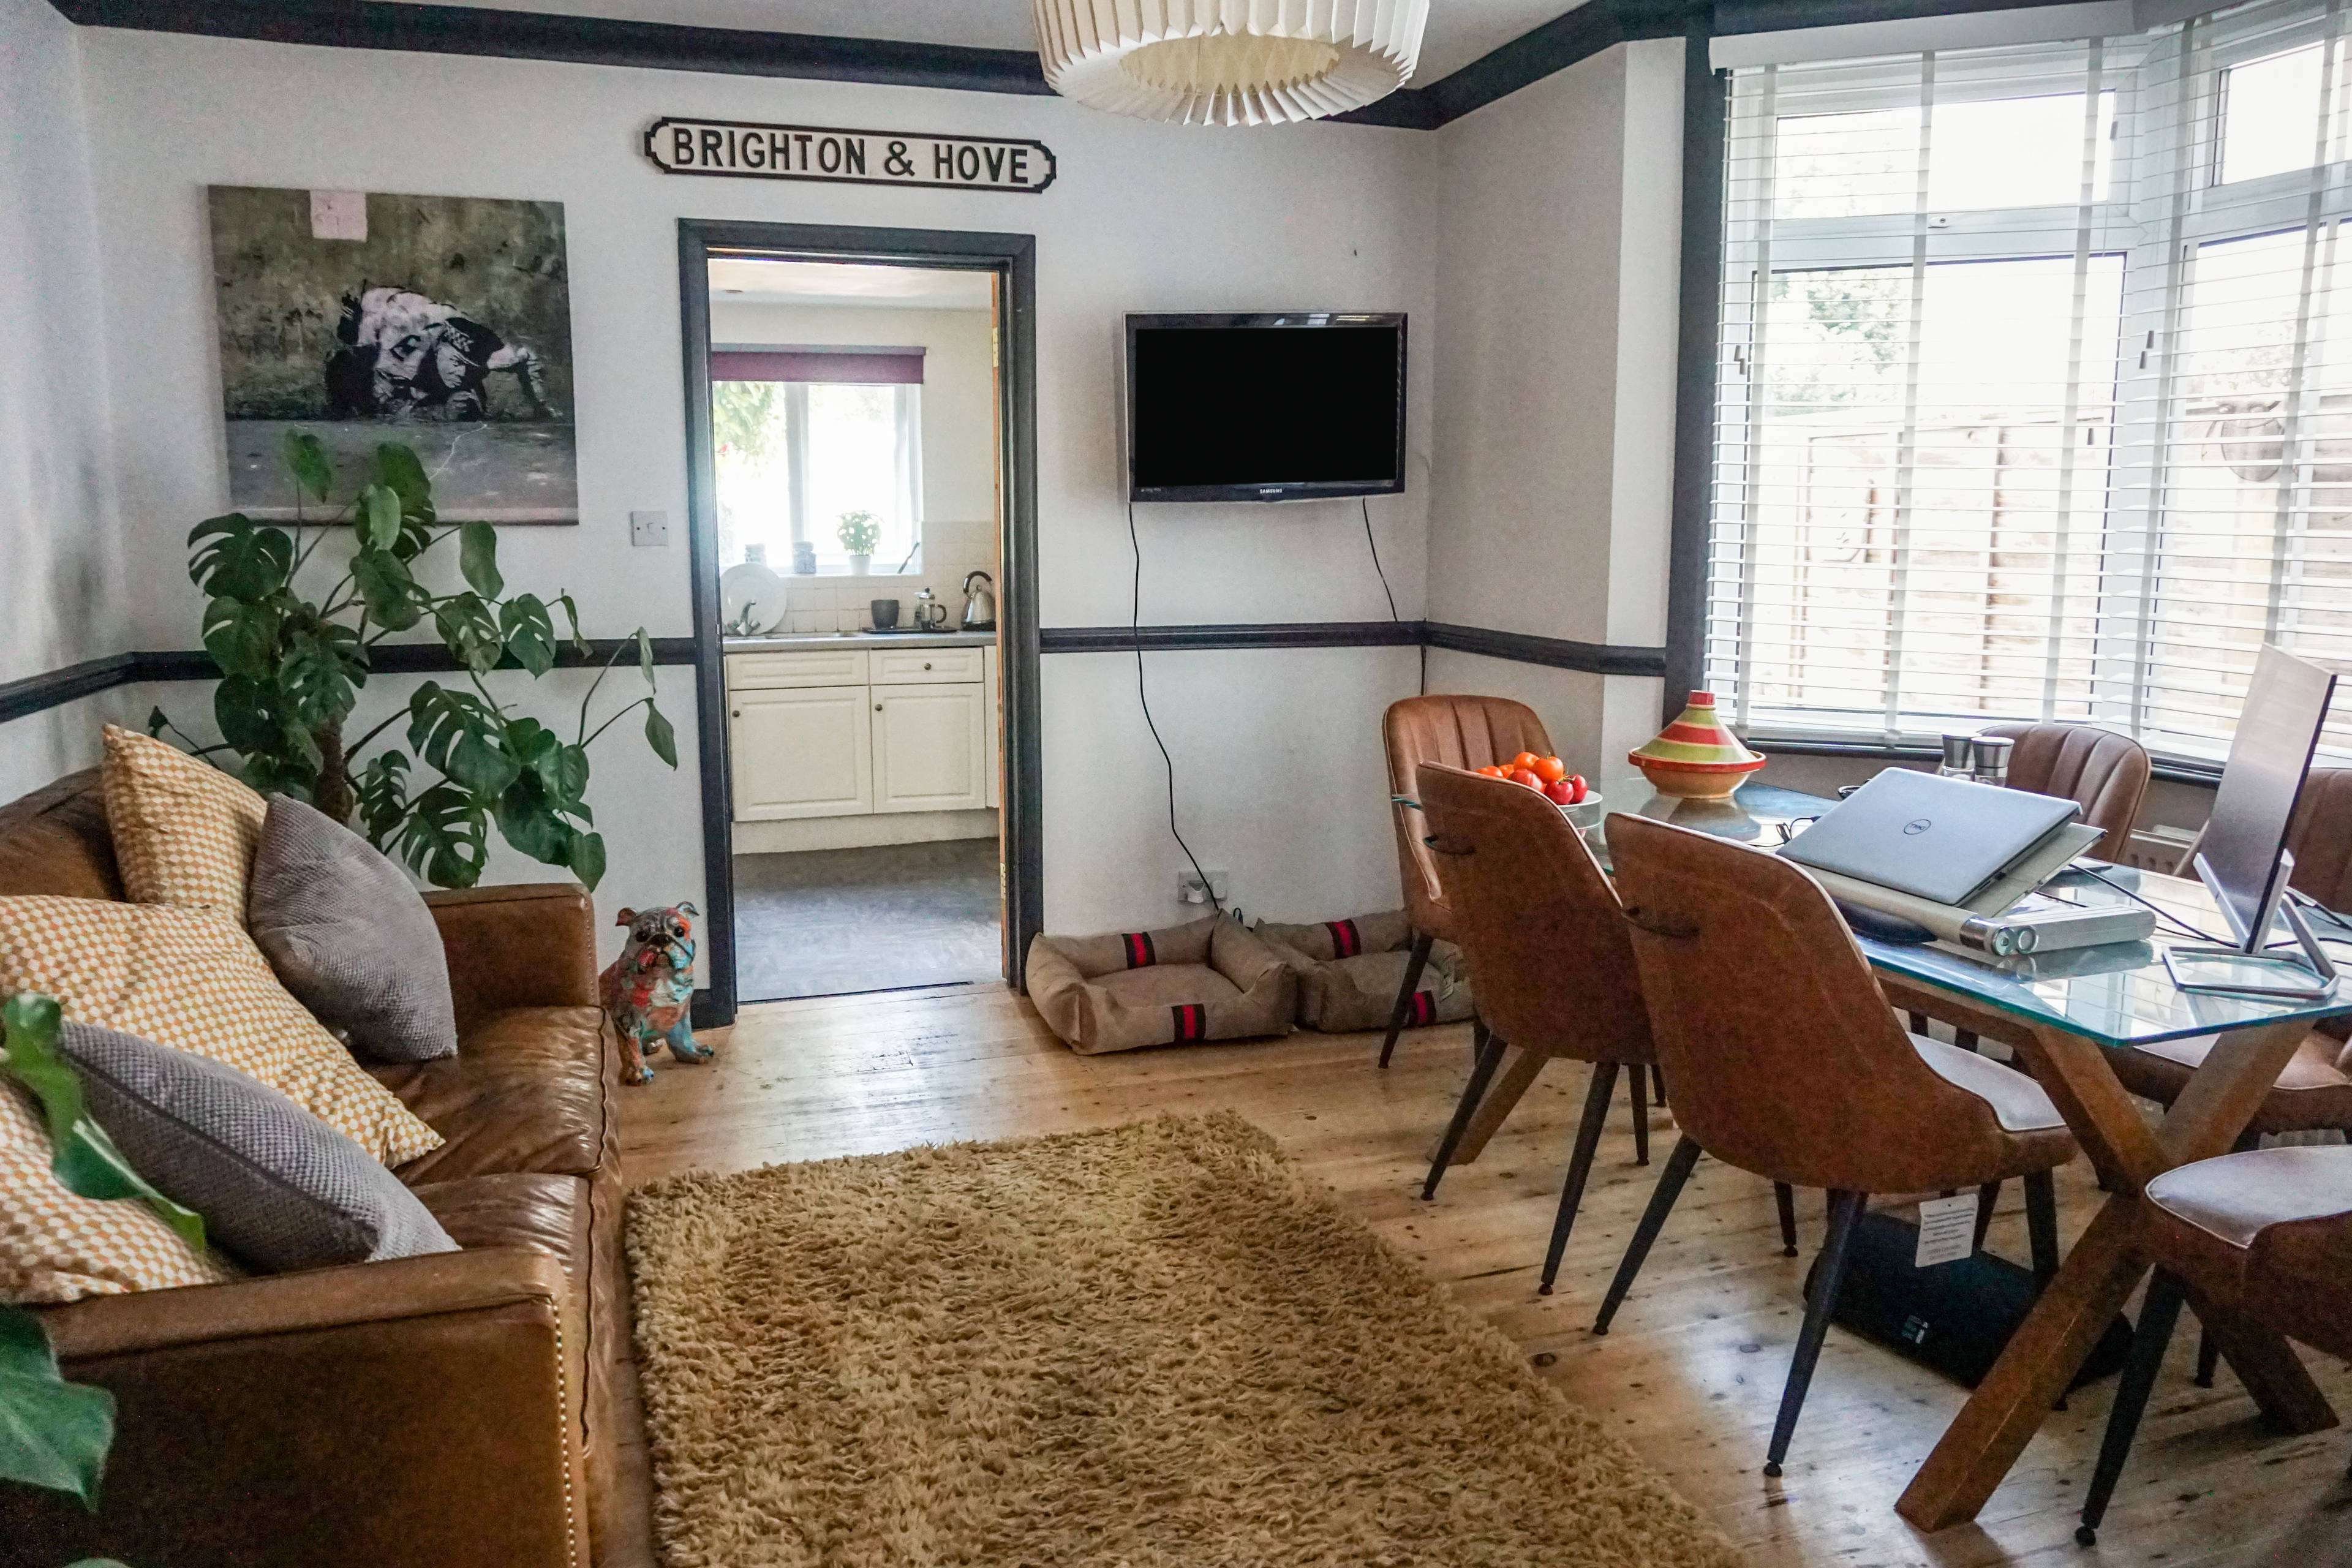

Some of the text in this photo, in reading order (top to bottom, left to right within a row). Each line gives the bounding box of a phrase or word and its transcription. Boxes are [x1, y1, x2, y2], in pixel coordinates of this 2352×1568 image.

[673, 128, 1028, 184] BRIGHTON & HOVE
